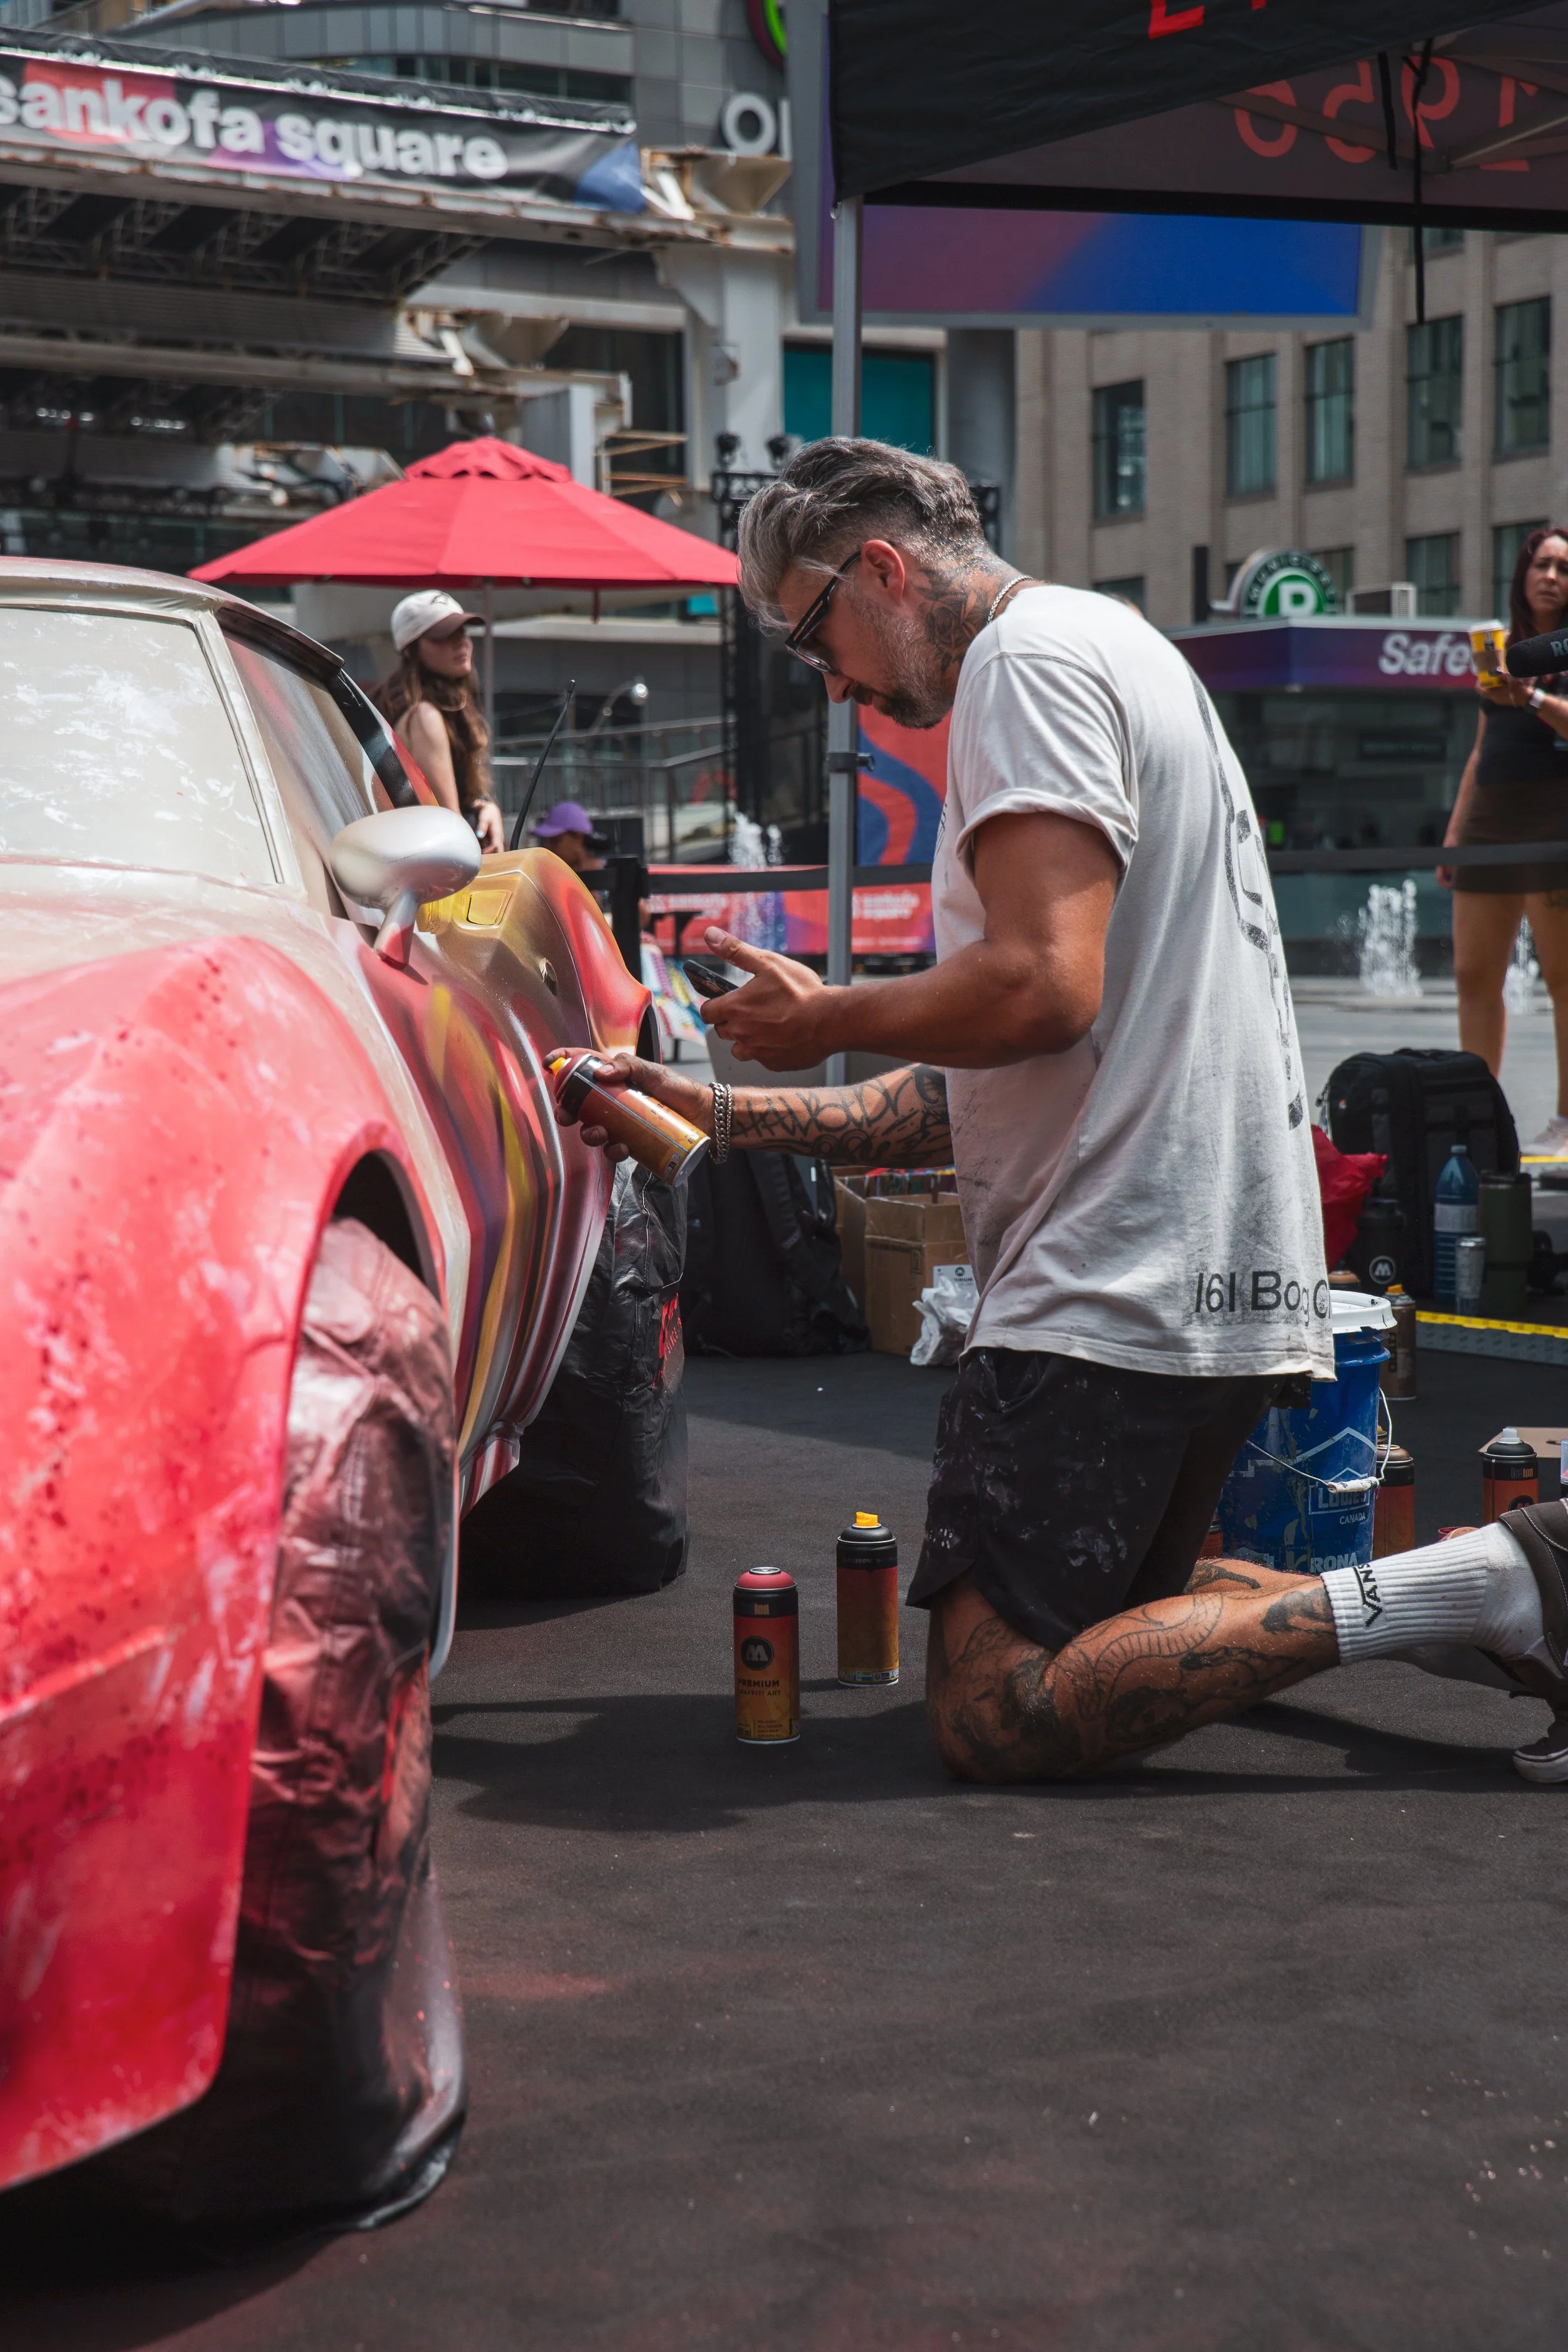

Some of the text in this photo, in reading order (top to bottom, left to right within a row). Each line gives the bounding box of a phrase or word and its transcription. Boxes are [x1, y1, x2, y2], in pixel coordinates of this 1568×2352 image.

[277, 114, 509, 180] square
[1379, 631, 1476, 676] Safe
[1195, 1271, 1237, 1313] 161
[1339, 1511, 1367, 1525] CANADA
[1310, 1552, 1359, 1573] RONA
[744, 1644, 769, 1661] M
[738, 1678, 780, 1687] PREMIUM
